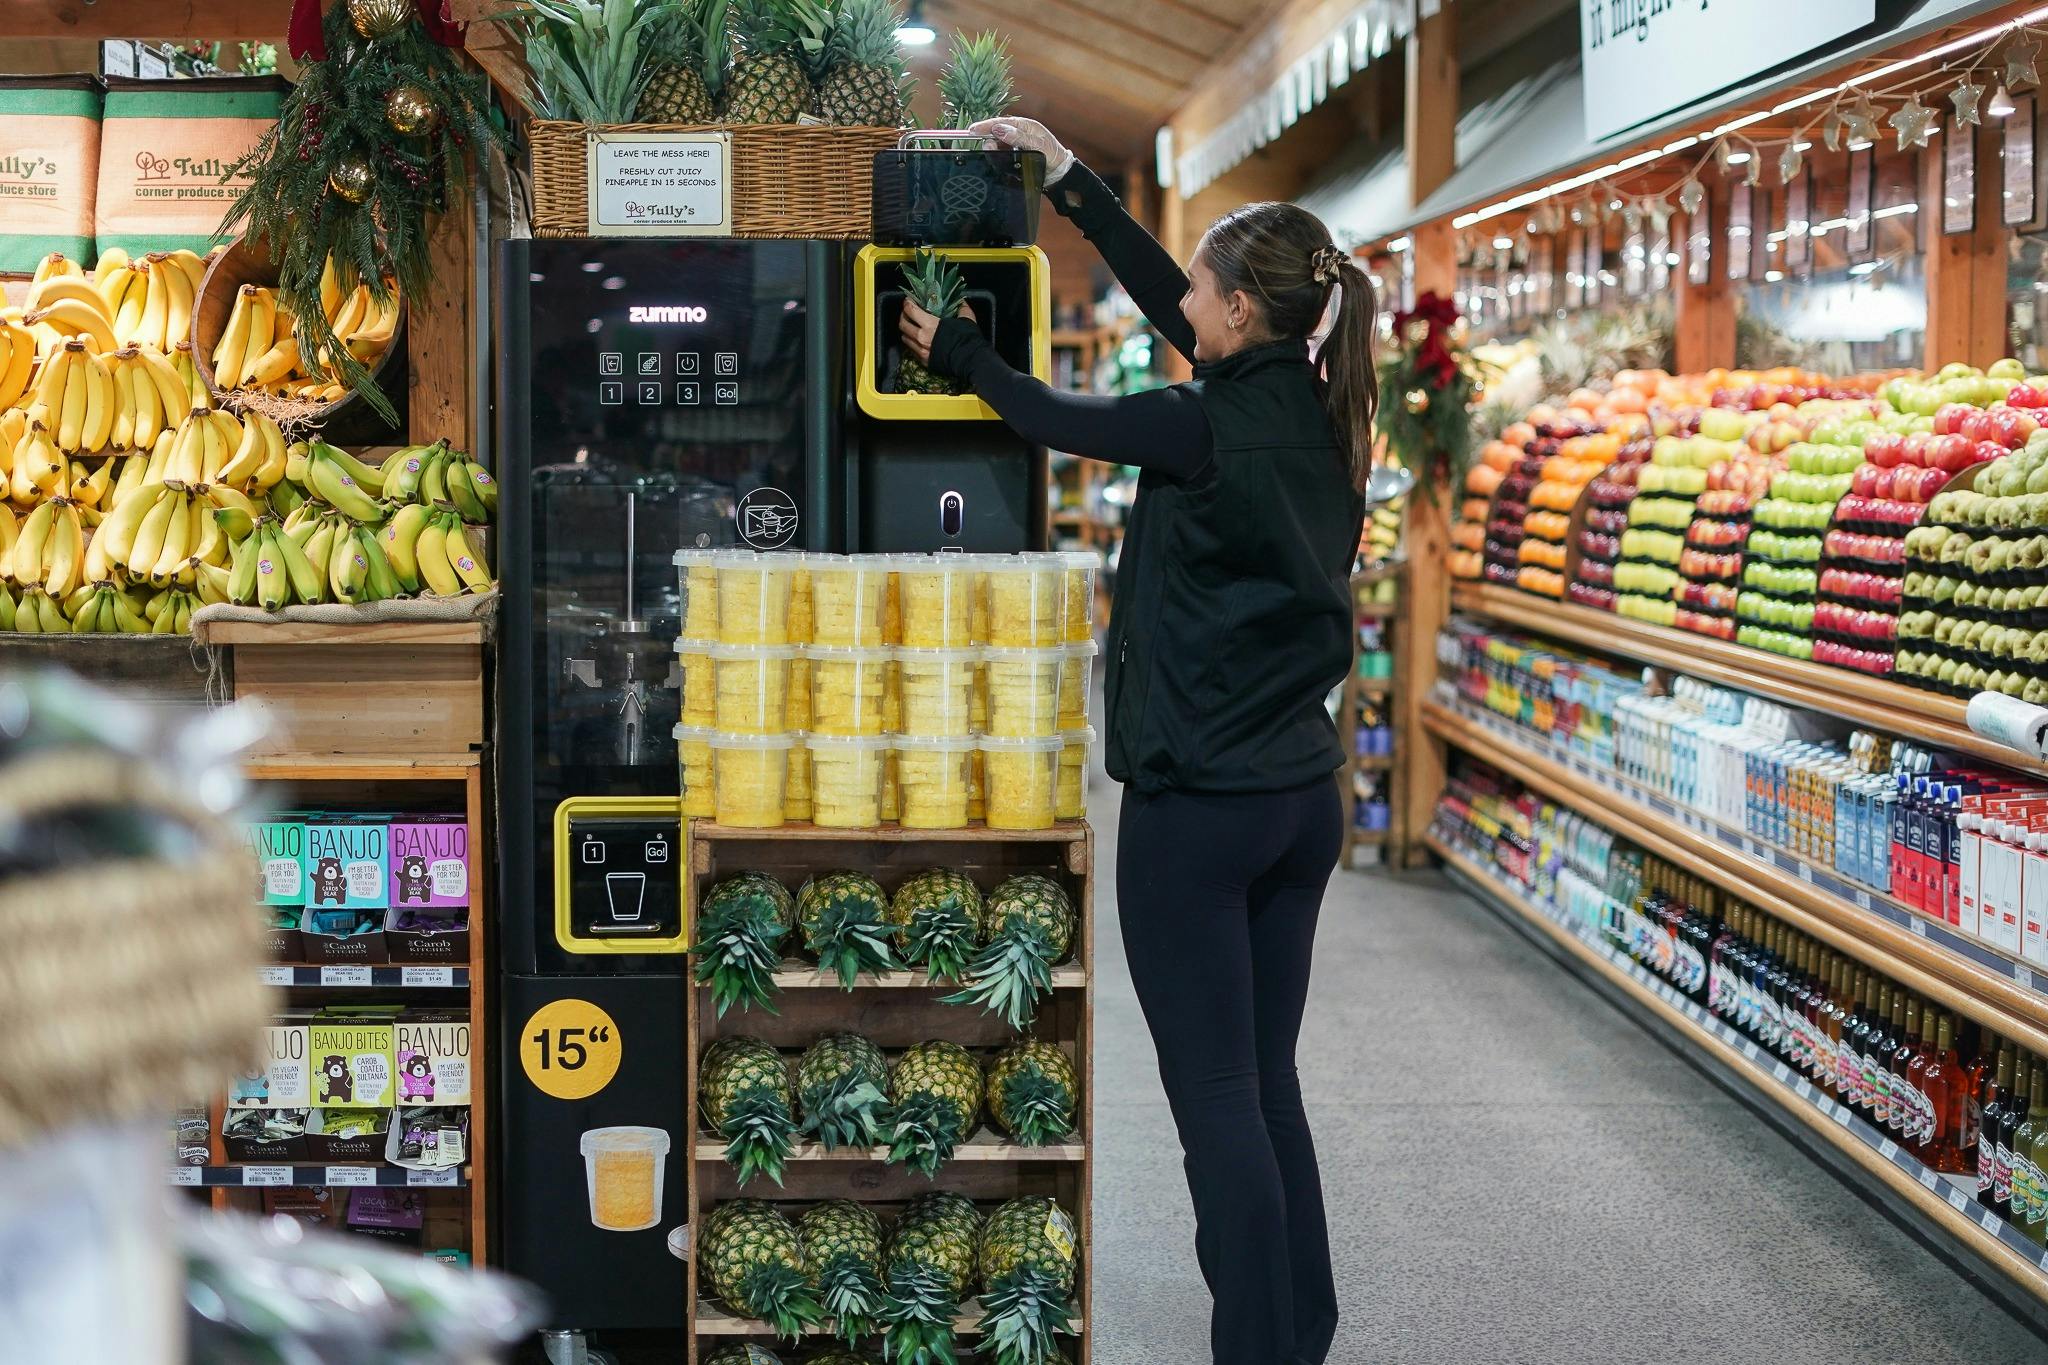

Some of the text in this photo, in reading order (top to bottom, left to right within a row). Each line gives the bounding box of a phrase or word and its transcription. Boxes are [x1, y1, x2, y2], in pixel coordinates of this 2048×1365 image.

[1612, 0, 1671, 42] mig
[613, 150, 710, 158] LEAVE THE MESS HERE!
[0, 156, 56, 180] lly's
[173, 157, 257, 177] Tull
[619, 168, 702, 176] FRESHLY CUT JUICY
[605, 179, 716, 187] PINEAPPLE IN 15 SECONDS
[27, 185, 57, 196] store
[135, 187, 246, 199] corner produce sto
[647, 204, 695, 218] Tully's
[629, 306, 707, 323] zummo
[608, 387, 737, 400] 1 2 3 Go!
[243, 826, 301, 857] ANJO
[310, 828, 382, 860] BANJO
[395, 827, 466, 858] BANJO
[591, 847, 666, 858] 1 Go!
[276, 862, 298, 870] BETTER
[357, 865, 378, 873] BETTER
[329, 942, 367, 950] Carob
[265, 1029, 303, 1060] NJO
[314, 1031, 388, 1050] BANJO BITES
[399, 1026, 470, 1057] BANJO
[356, 1057, 377, 1065] CAROB
[281, 1065, 299, 1073] VEGAN
[360, 1065, 384, 1073] COATED
[356, 1073, 387, 1081] SULTANAS
